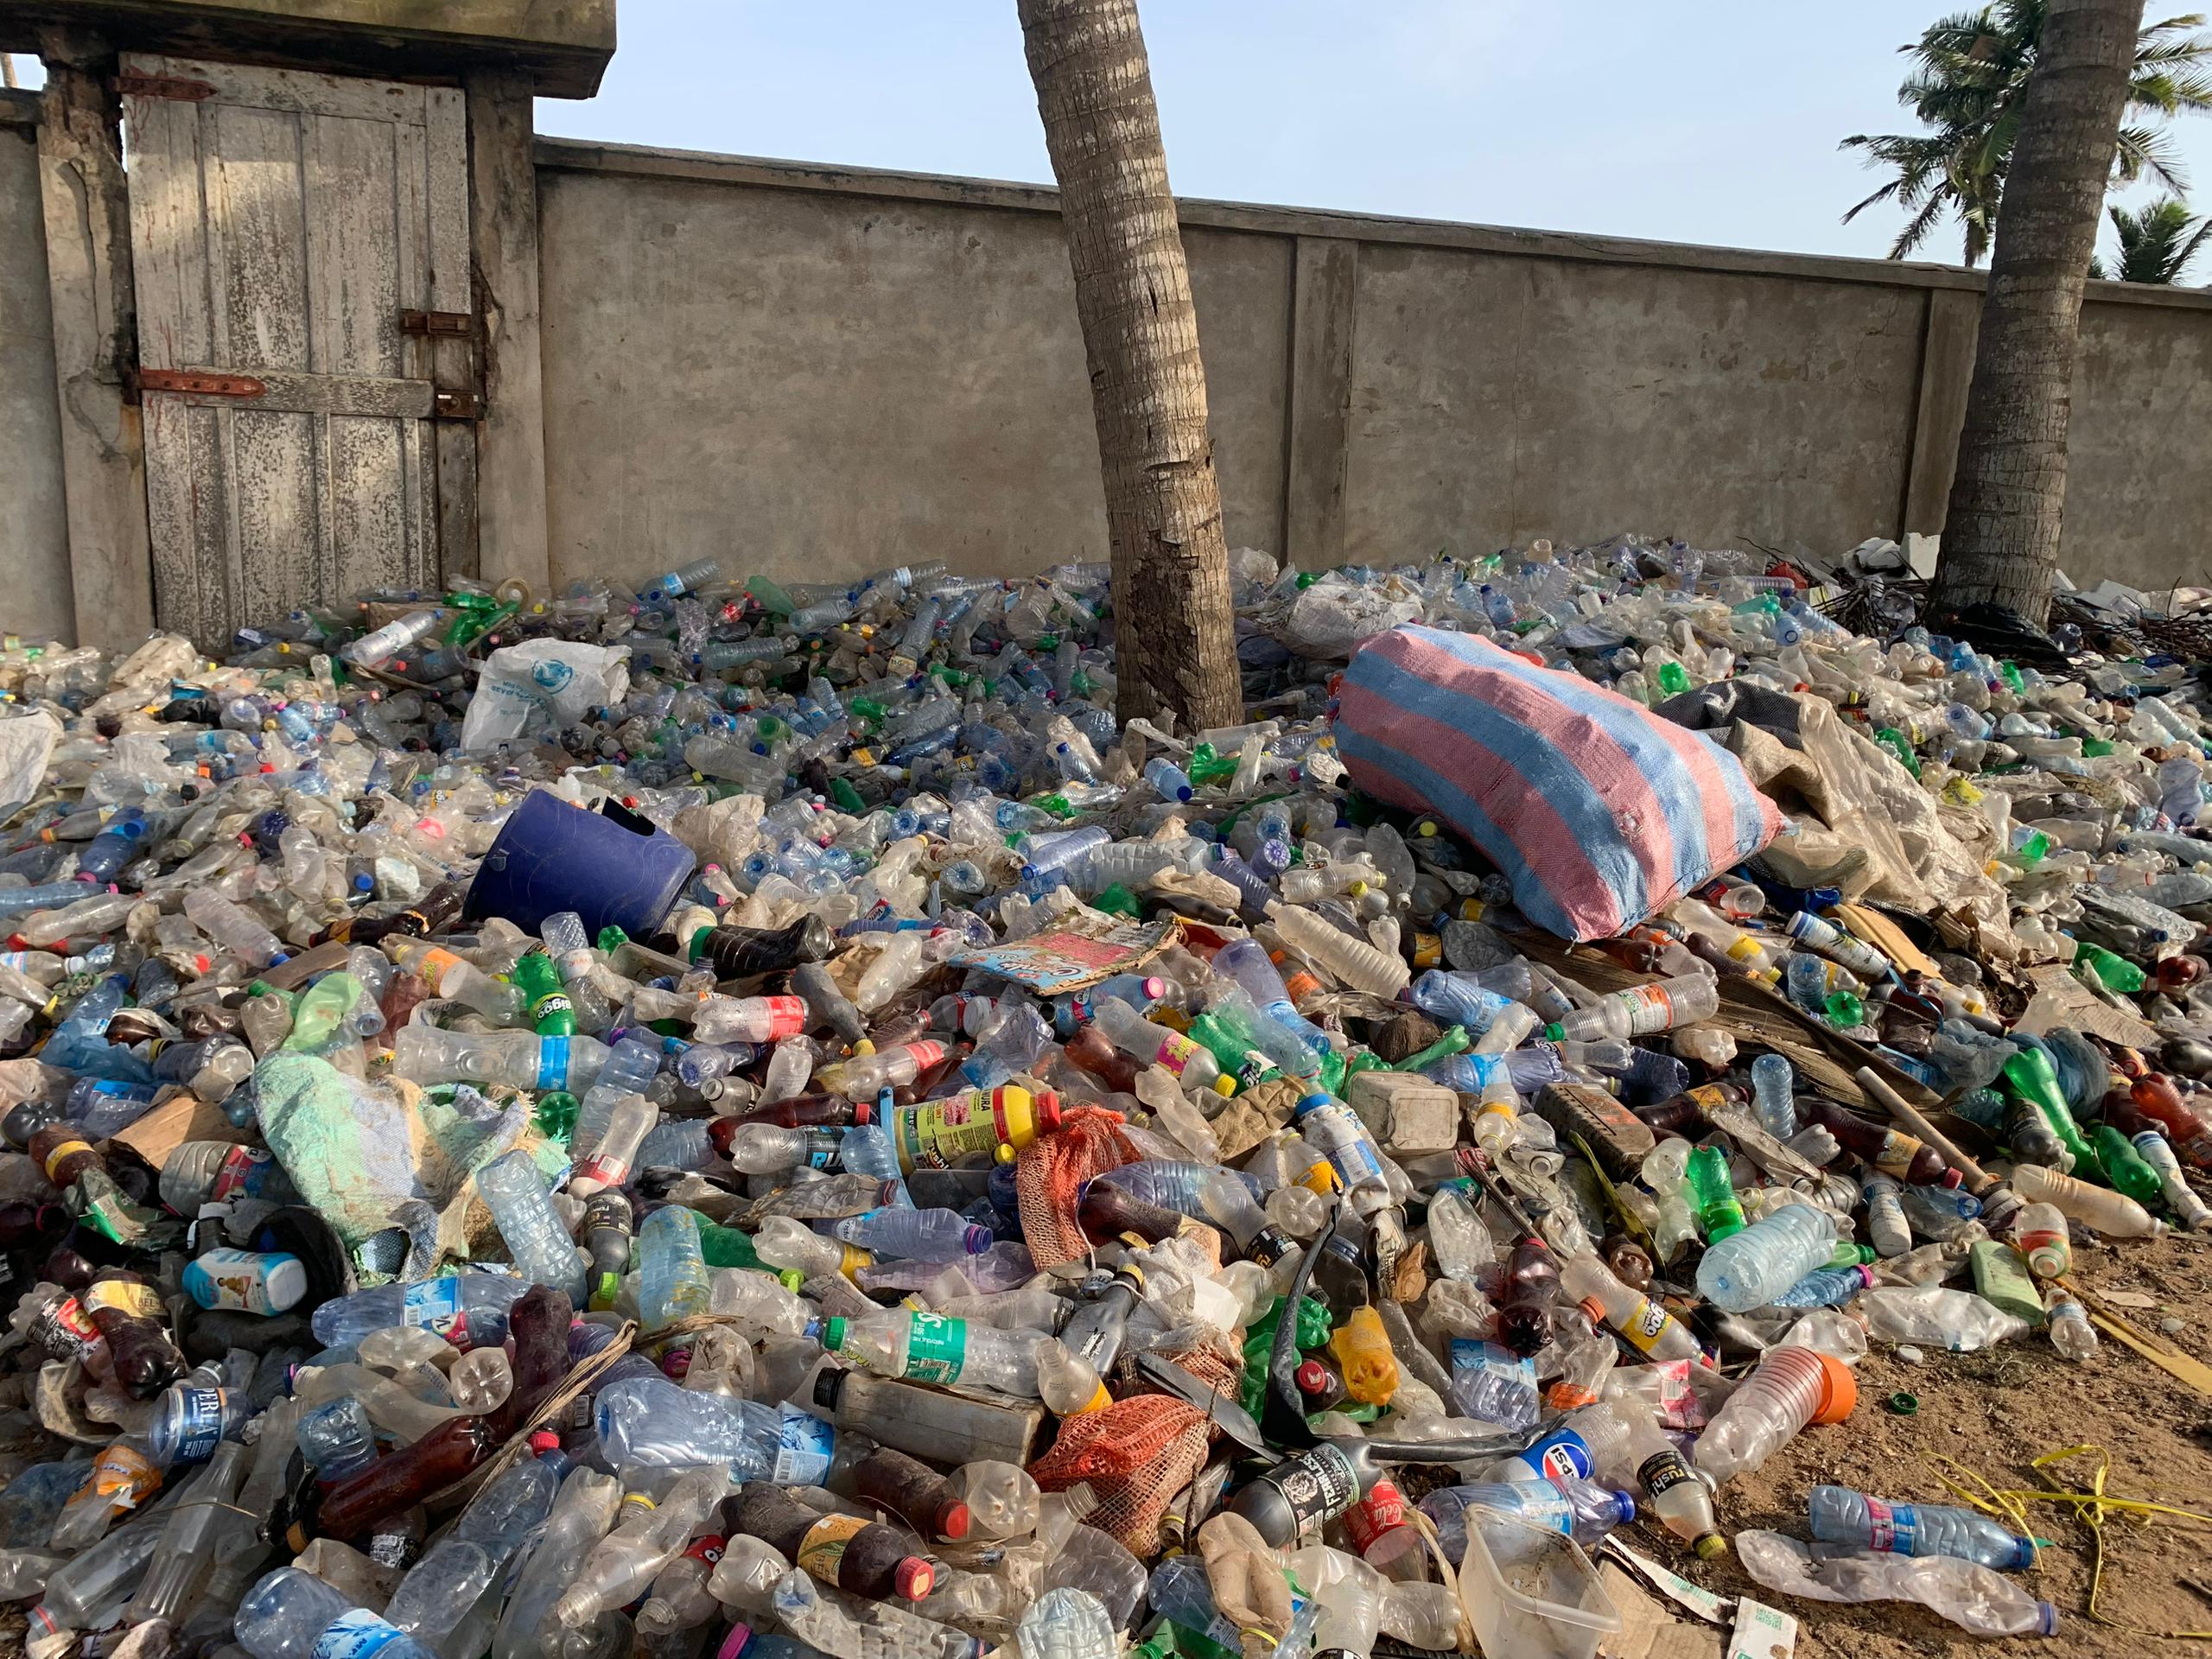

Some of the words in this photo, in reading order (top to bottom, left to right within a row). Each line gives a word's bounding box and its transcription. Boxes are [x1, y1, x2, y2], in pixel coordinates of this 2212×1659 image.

[537, 997, 572, 1020] Bigoo
[193, 1388, 219, 1434] PERLA
[1549, 1447, 1573, 1478] PSI
[1304, 1452, 1340, 1507] FEARLESS
[1650, 1468, 1684, 1490] rush!
[1370, 1501, 1404, 1531] Cola
